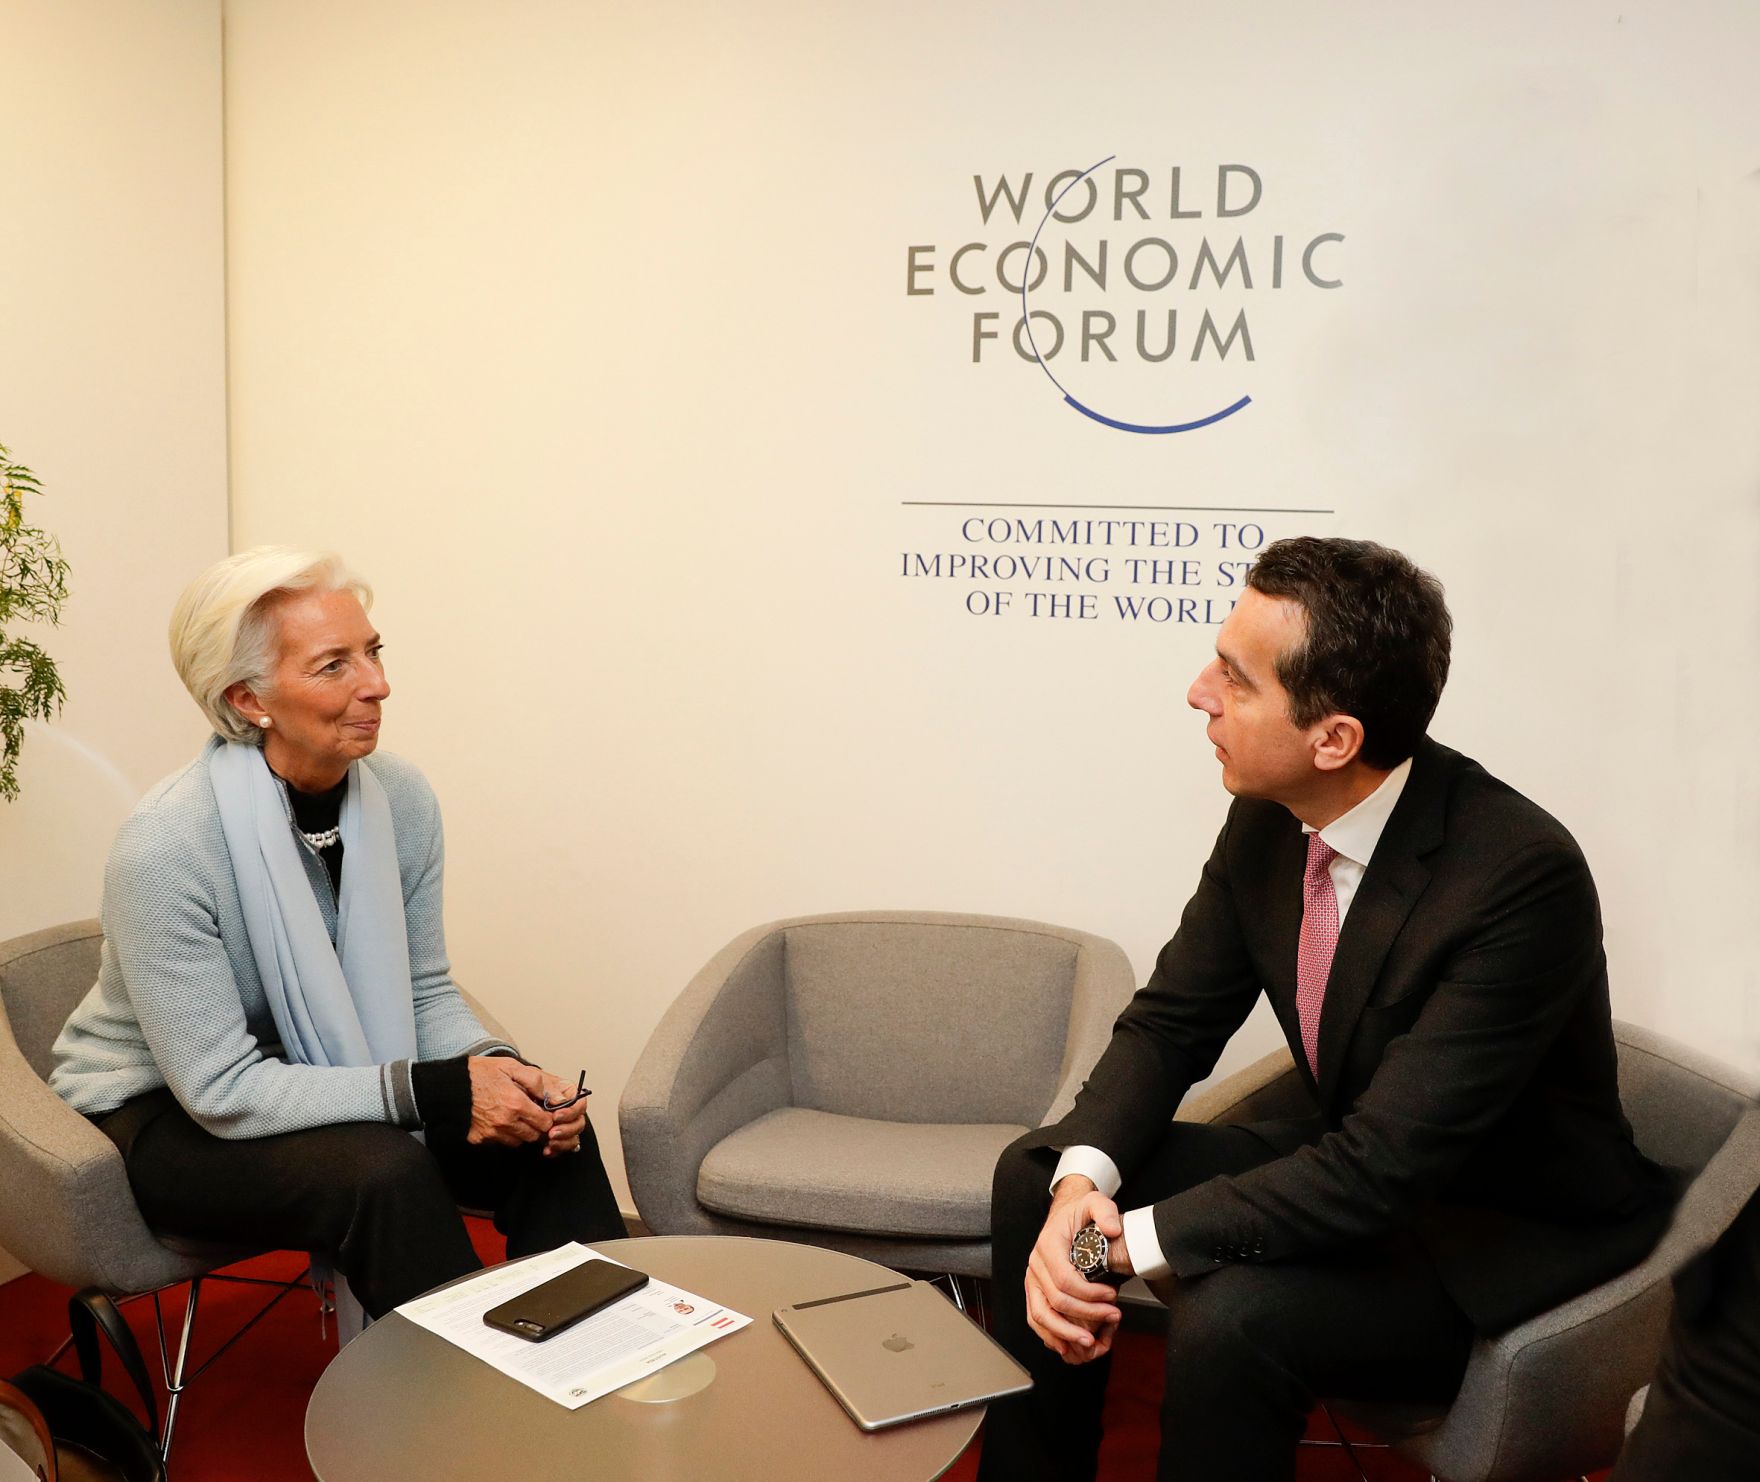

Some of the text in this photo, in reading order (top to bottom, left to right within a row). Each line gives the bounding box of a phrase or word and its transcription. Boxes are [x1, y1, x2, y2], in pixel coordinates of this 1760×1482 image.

[973, 164, 1262, 226] WORLD
[907, 232, 1345, 296] ECONOMIC
[972, 307, 1256, 363] FORUM
[961, 517, 1264, 550] COMMITTED TO
[901, 552, 1110, 583] IMPROVING
[1125, 559, 1202, 586] THE
[966, 590, 1236, 625] OF THE WORL
